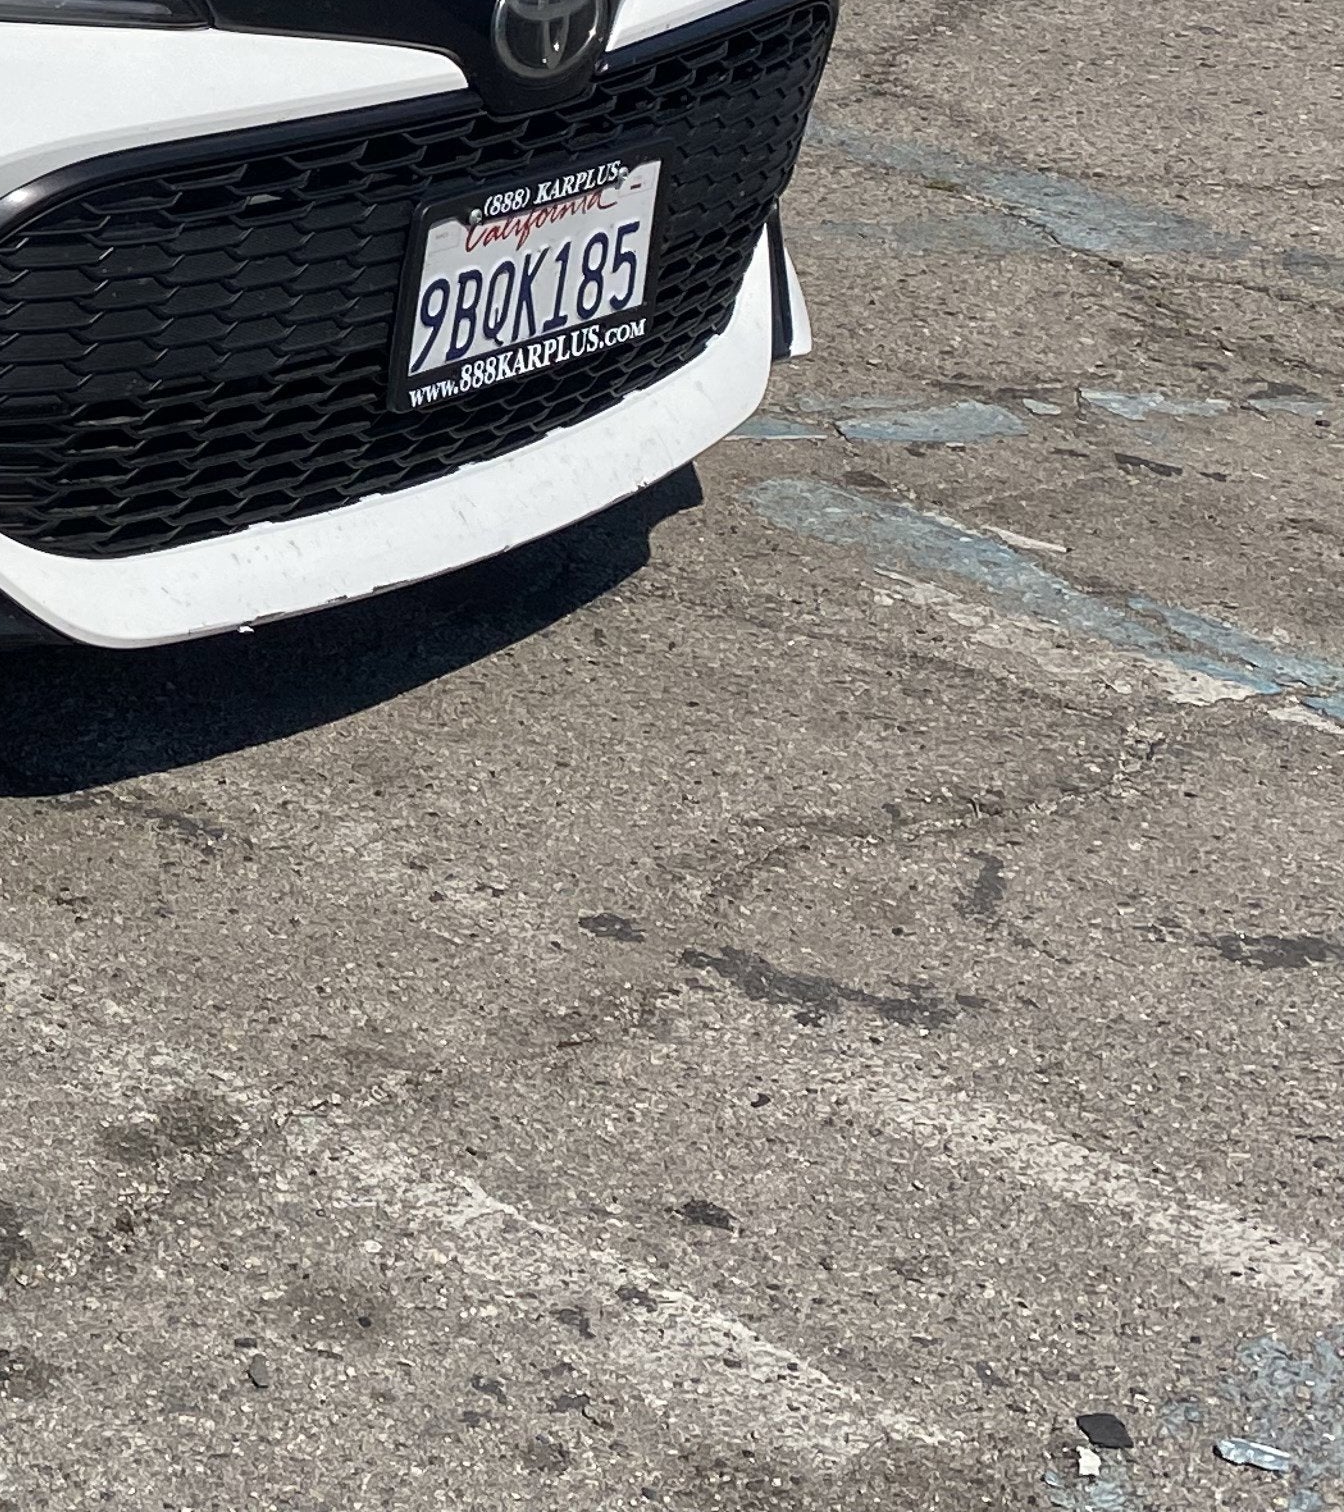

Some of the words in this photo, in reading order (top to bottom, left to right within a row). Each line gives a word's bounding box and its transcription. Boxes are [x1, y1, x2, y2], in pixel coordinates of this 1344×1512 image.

[483, 189, 532, 216] (888)
[533, 159, 623, 206] KARPLUS
[408, 220, 641, 374] 9BQK185
